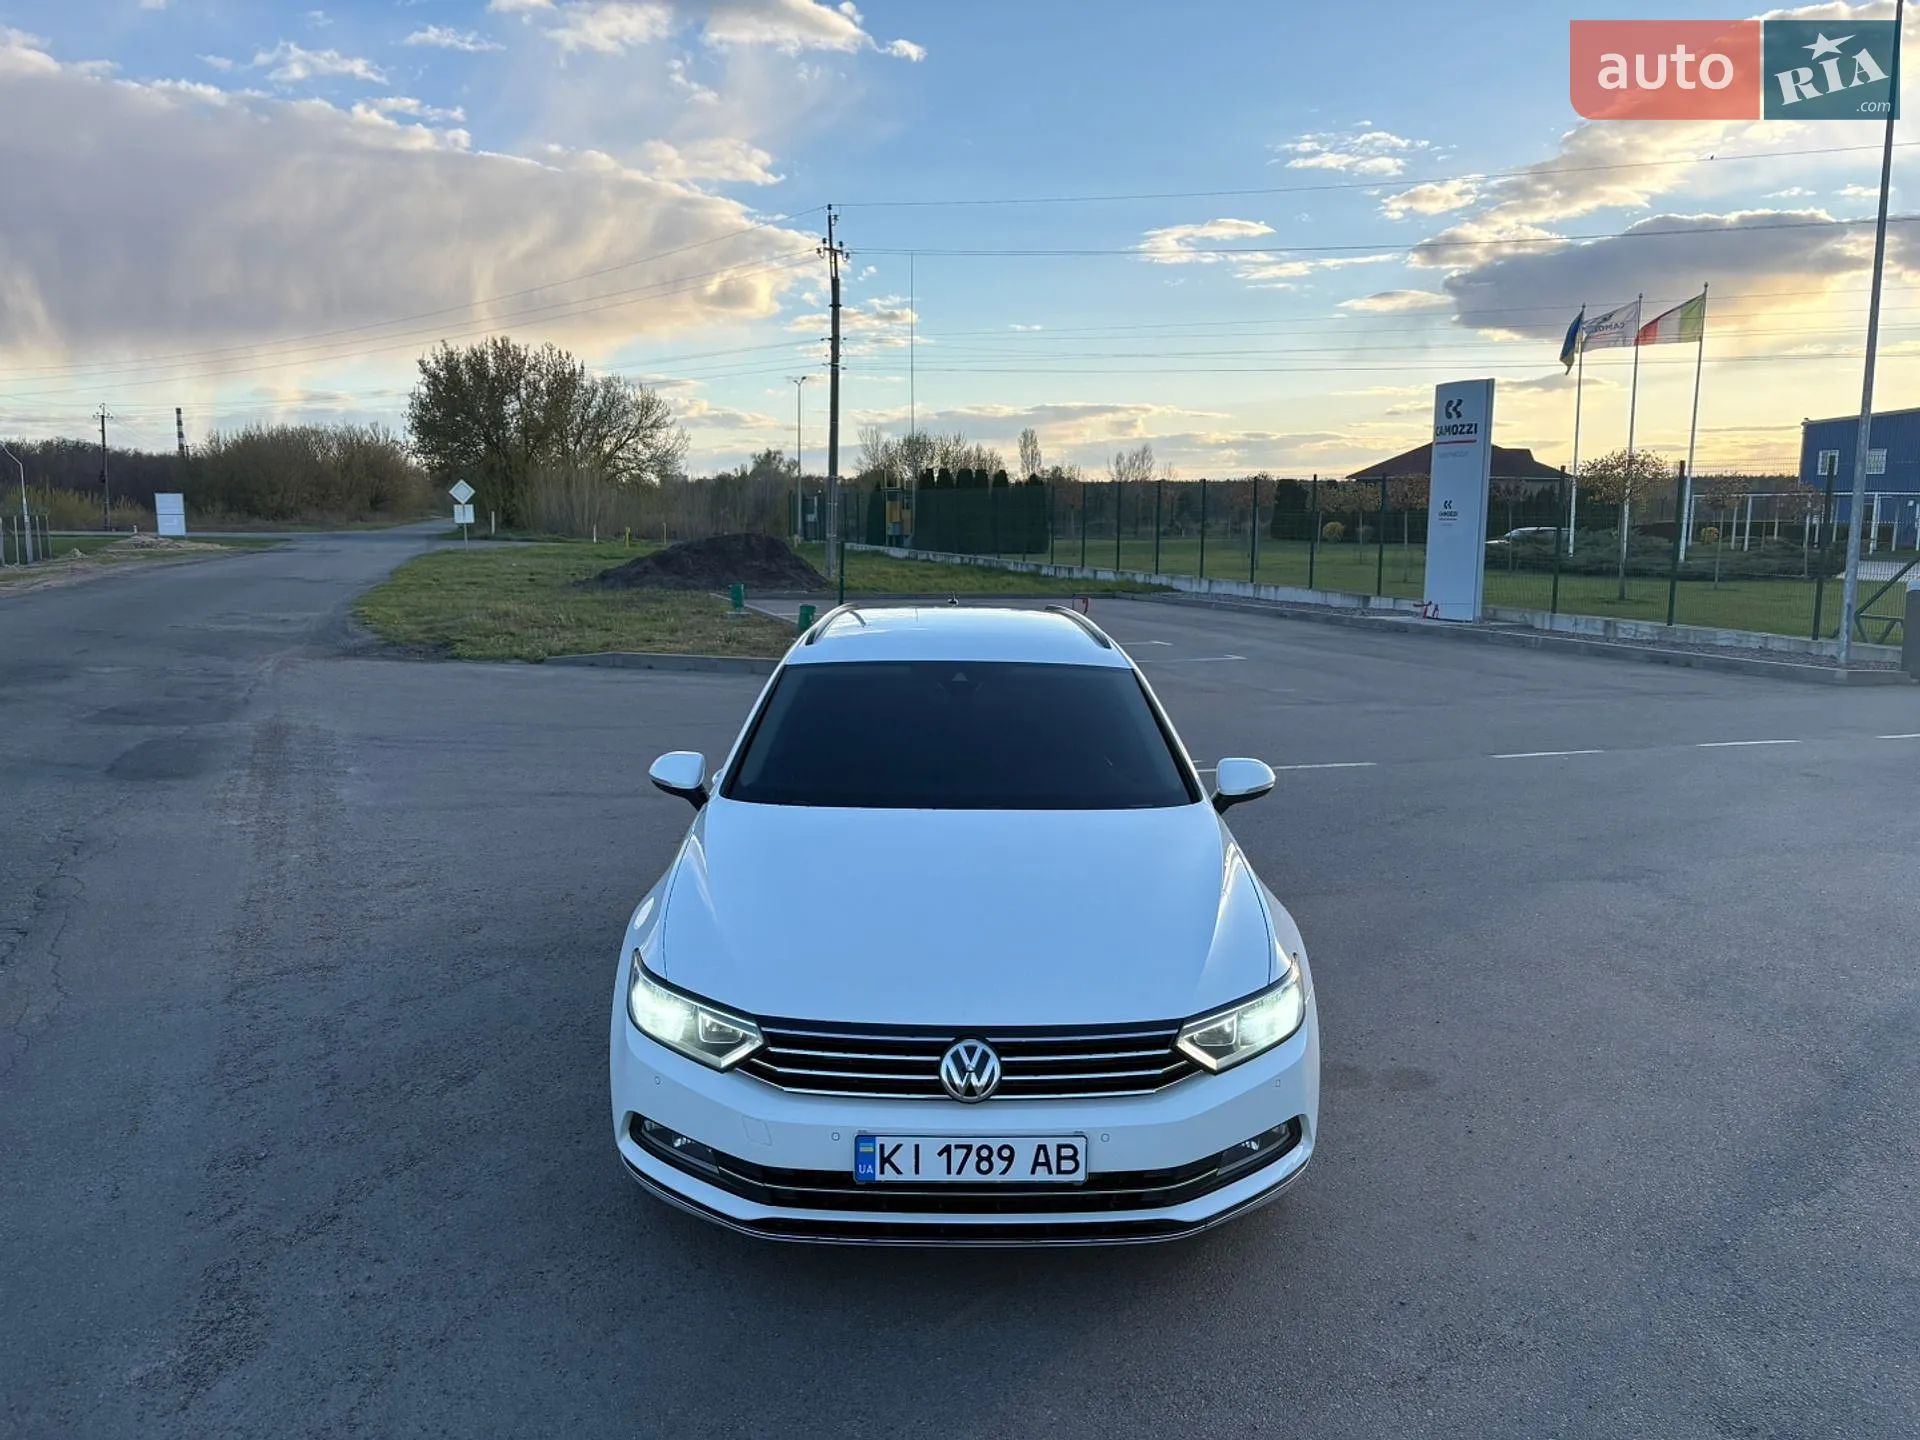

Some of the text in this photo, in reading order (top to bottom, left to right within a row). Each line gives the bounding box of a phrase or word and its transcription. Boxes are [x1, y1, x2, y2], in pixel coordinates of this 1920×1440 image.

[1436, 423, 1478, 437] CAMOZZI
[879, 1143, 1080, 1176] KI 1789 AB
[859, 1164, 874, 1174] UA
